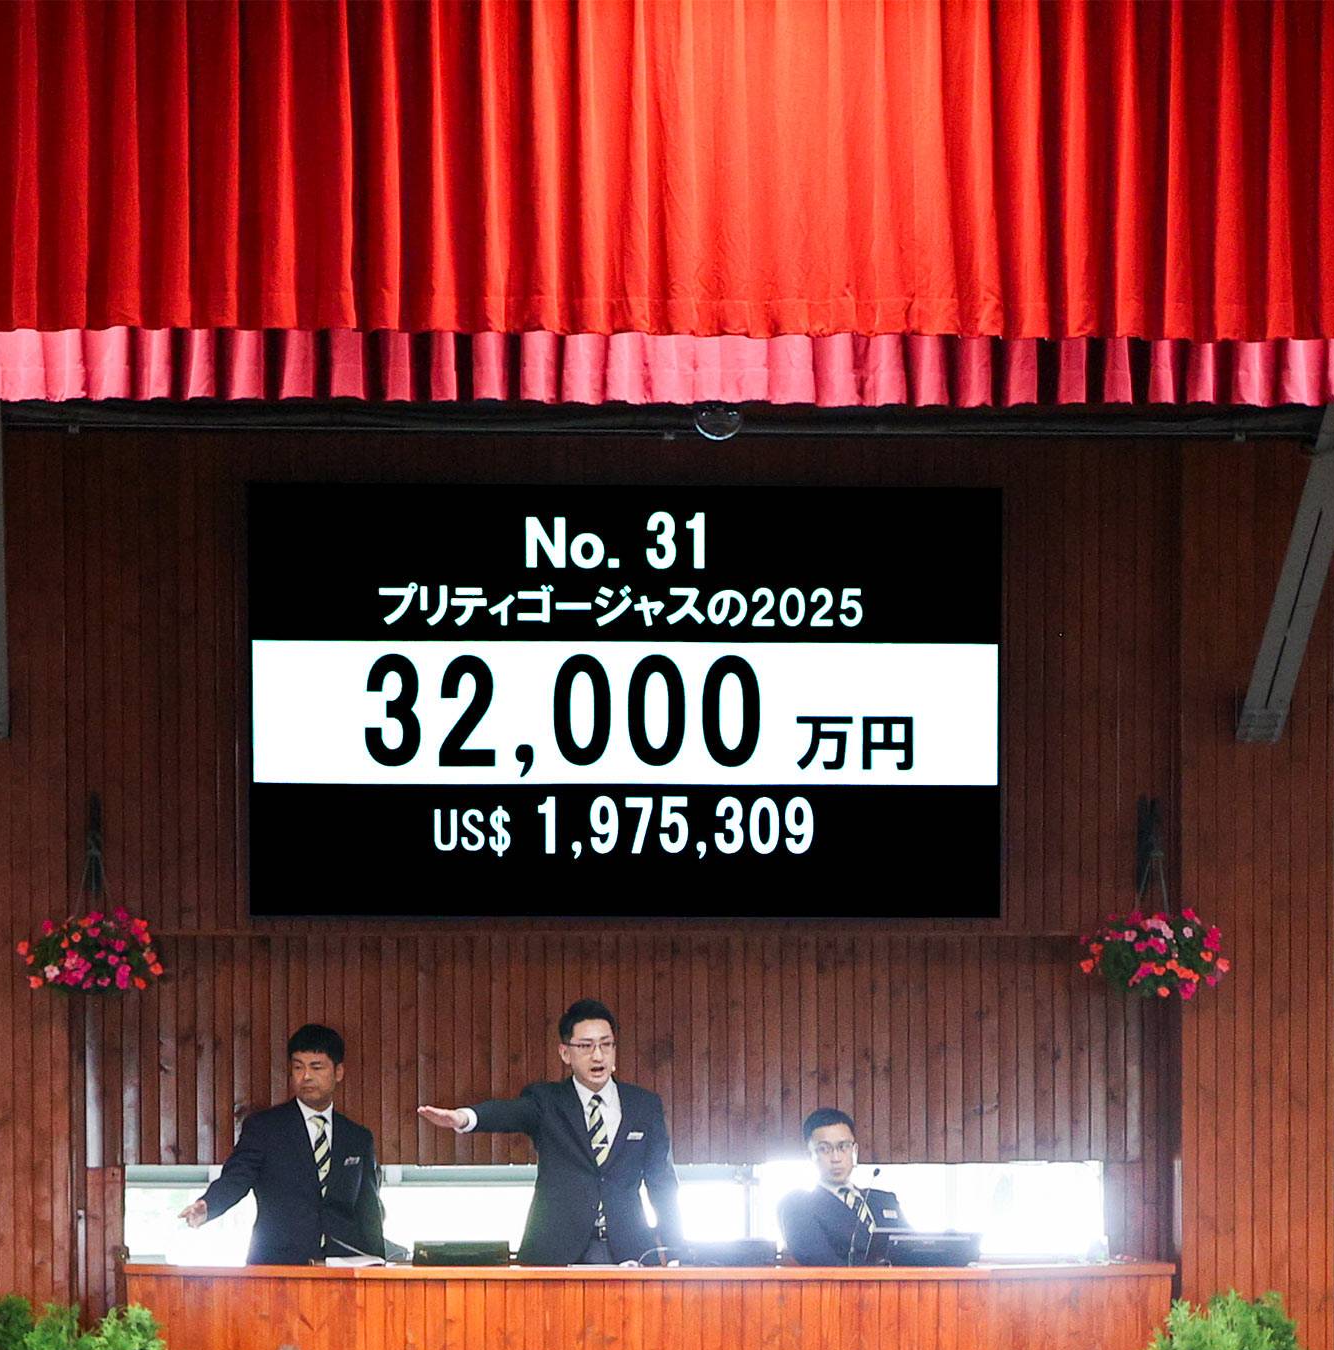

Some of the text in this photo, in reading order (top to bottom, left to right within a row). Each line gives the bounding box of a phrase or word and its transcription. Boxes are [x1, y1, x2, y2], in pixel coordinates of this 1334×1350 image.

[525, 511, 706, 570] No. 31
[378, 581, 863, 628] プリティゴージャスの2025
[364, 653, 914, 778] 32,000 万円
[433, 795, 814, 860] US$ 1,975,309
